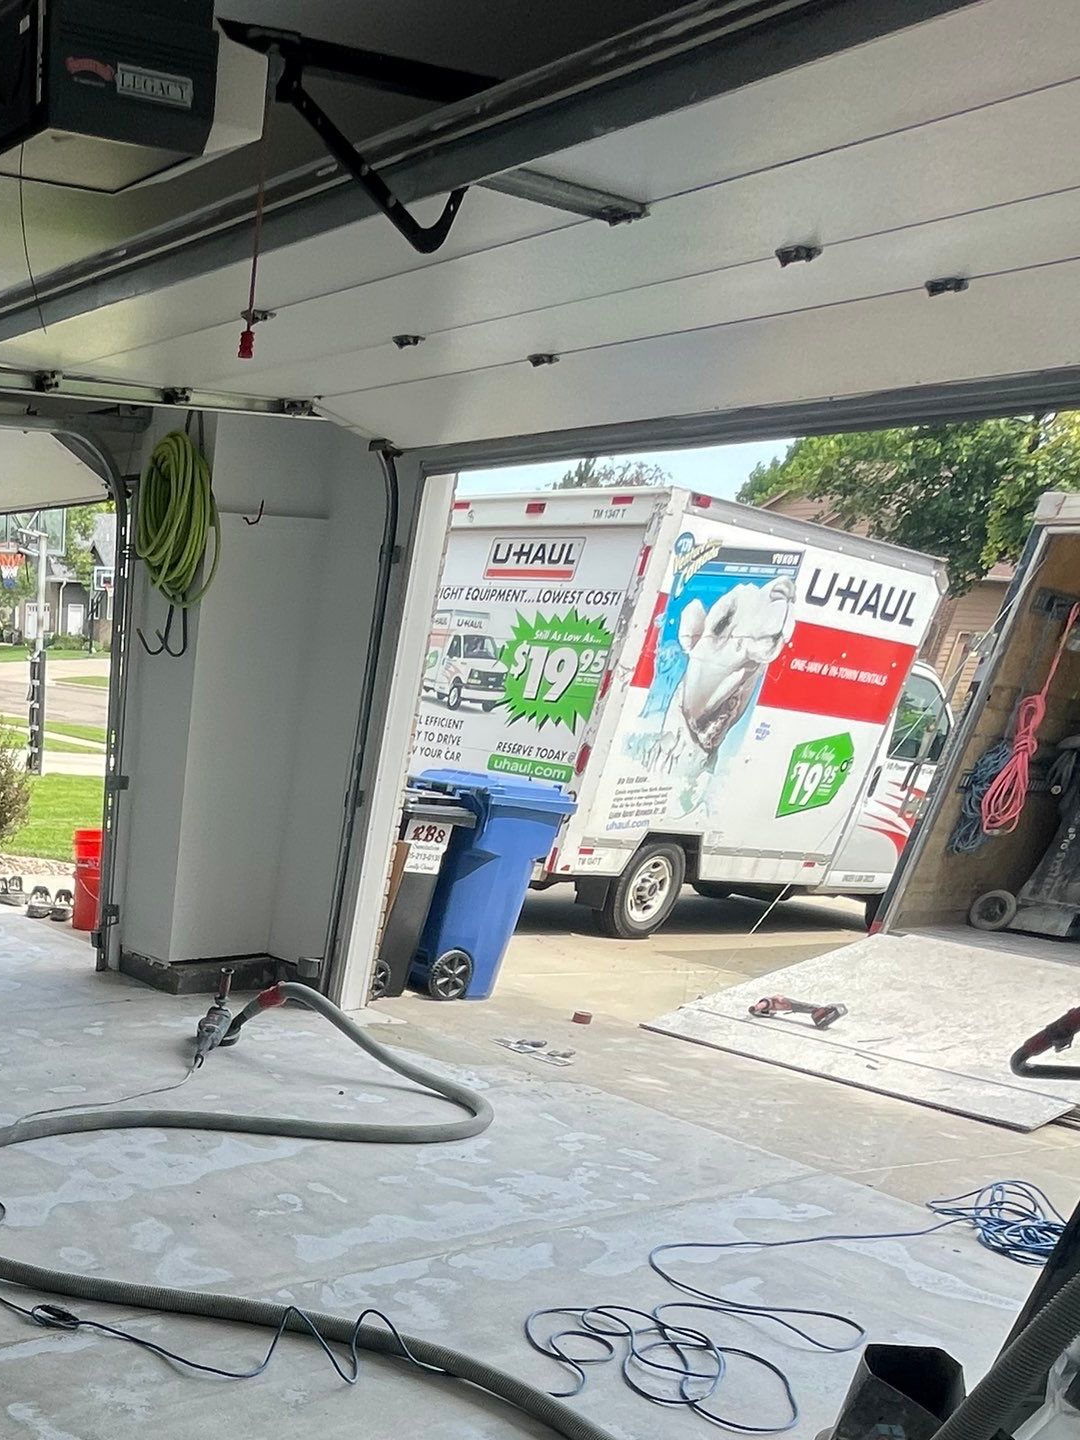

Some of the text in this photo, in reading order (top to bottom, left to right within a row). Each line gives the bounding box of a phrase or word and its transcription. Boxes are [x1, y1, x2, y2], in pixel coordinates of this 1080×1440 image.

[120, 73, 188, 100] LEGACY
[492, 543, 577, 565] U-HAUL
[585, 590, 622, 606] COST!
[805, 568, 917, 627] U-HAUL
[534, 629, 550, 640] Still
[551, 632, 562, 641] As
[563, 633, 580, 642] Low
[857, 669, 888, 686] RENTALS
[425, 715, 465, 730] EFFICIENT
[424, 731, 435, 742] TO
[436, 733, 461, 747] DRIVE
[420, 747, 443, 760] YOUR
[444, 750, 462, 762] CAR
[496, 741, 533, 757] RESERVE
[535, 747, 568, 762] TODAY
[493, 758, 567, 780] uhaul.com
